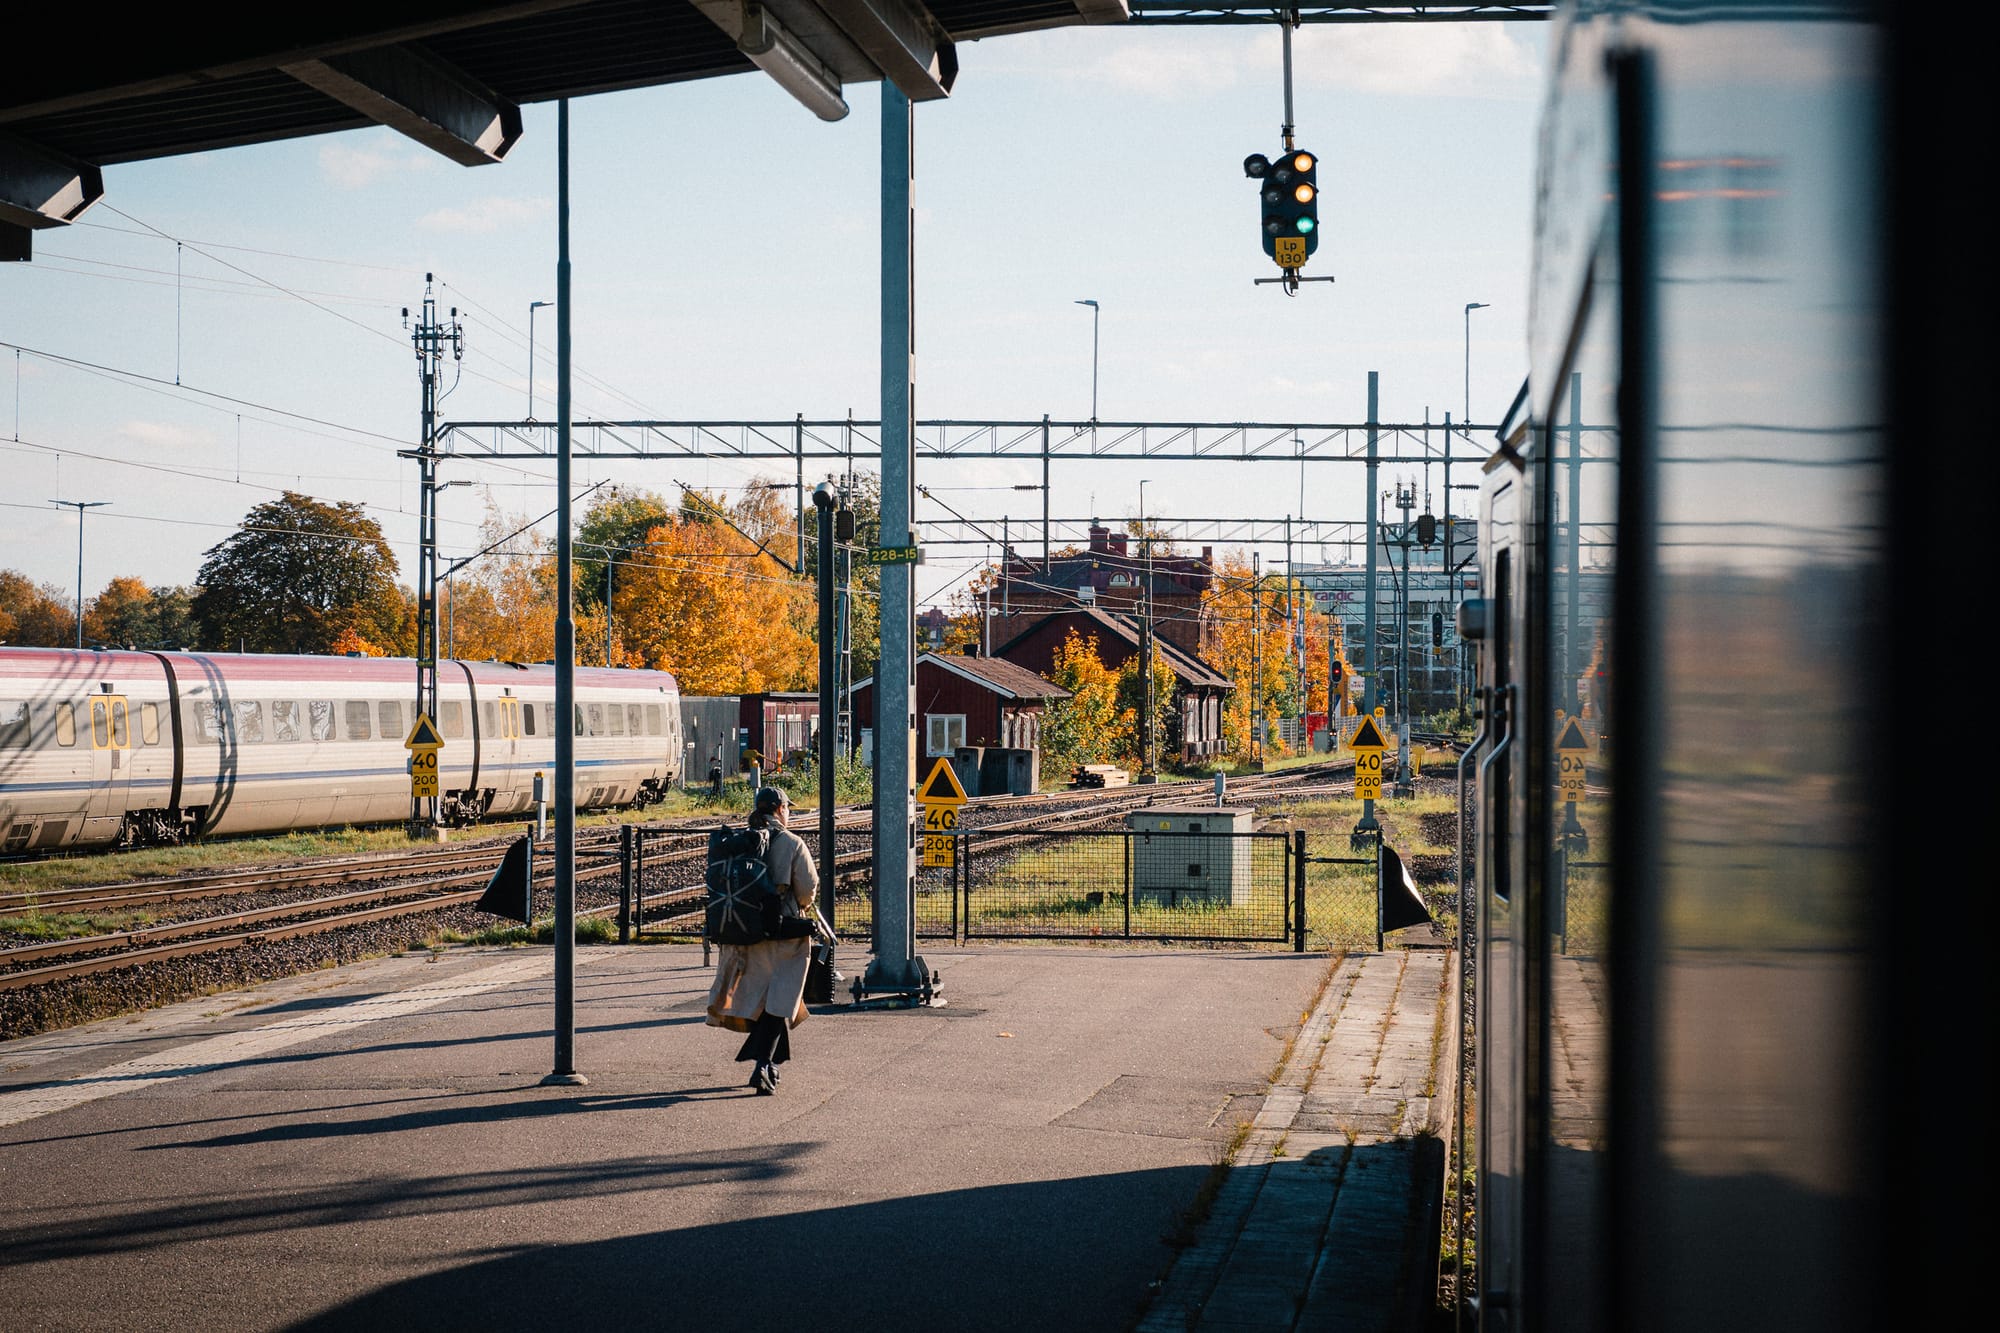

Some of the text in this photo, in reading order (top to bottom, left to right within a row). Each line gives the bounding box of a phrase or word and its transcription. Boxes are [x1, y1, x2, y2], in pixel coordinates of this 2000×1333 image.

[1284, 240, 1297, 252] Lp
[1280, 253, 1302, 264] 130
[871, 548, 917, 561] 228-15
[1311, 591, 1355, 601] candic
[412, 752, 438, 769] 40
[1357, 754, 1381, 770] 40
[414, 774, 438, 785] 200
[1356, 777, 1381, 787] 200
[421, 787, 431, 795] m
[1363, 789, 1373, 797] m
[927, 809, 956, 829] 40
[926, 838, 954, 851] 200
[934, 854, 945, 864] m
